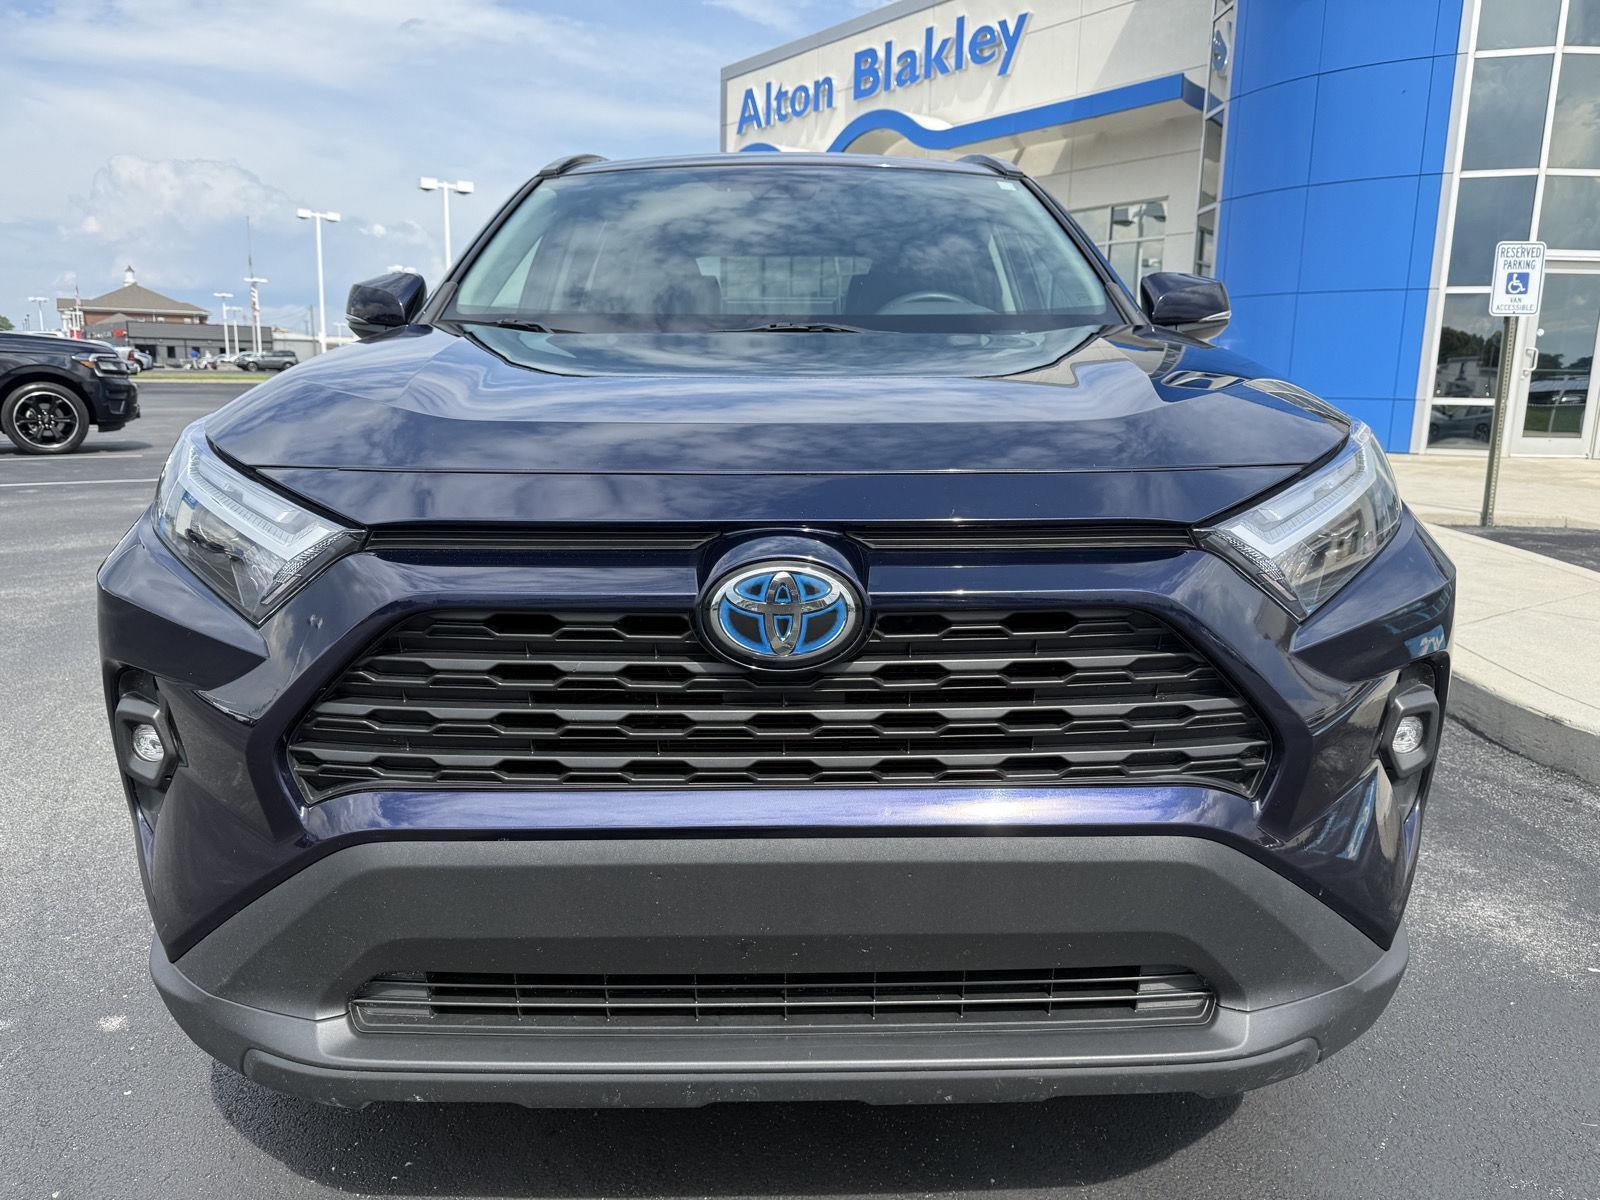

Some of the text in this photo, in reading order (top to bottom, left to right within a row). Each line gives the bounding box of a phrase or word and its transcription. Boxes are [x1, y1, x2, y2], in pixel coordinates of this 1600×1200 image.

[737, 12, 1031, 135] Alton Blakley
[1500, 247, 1542, 258] RESERVED
[1502, 259, 1536, 270] PARKING
